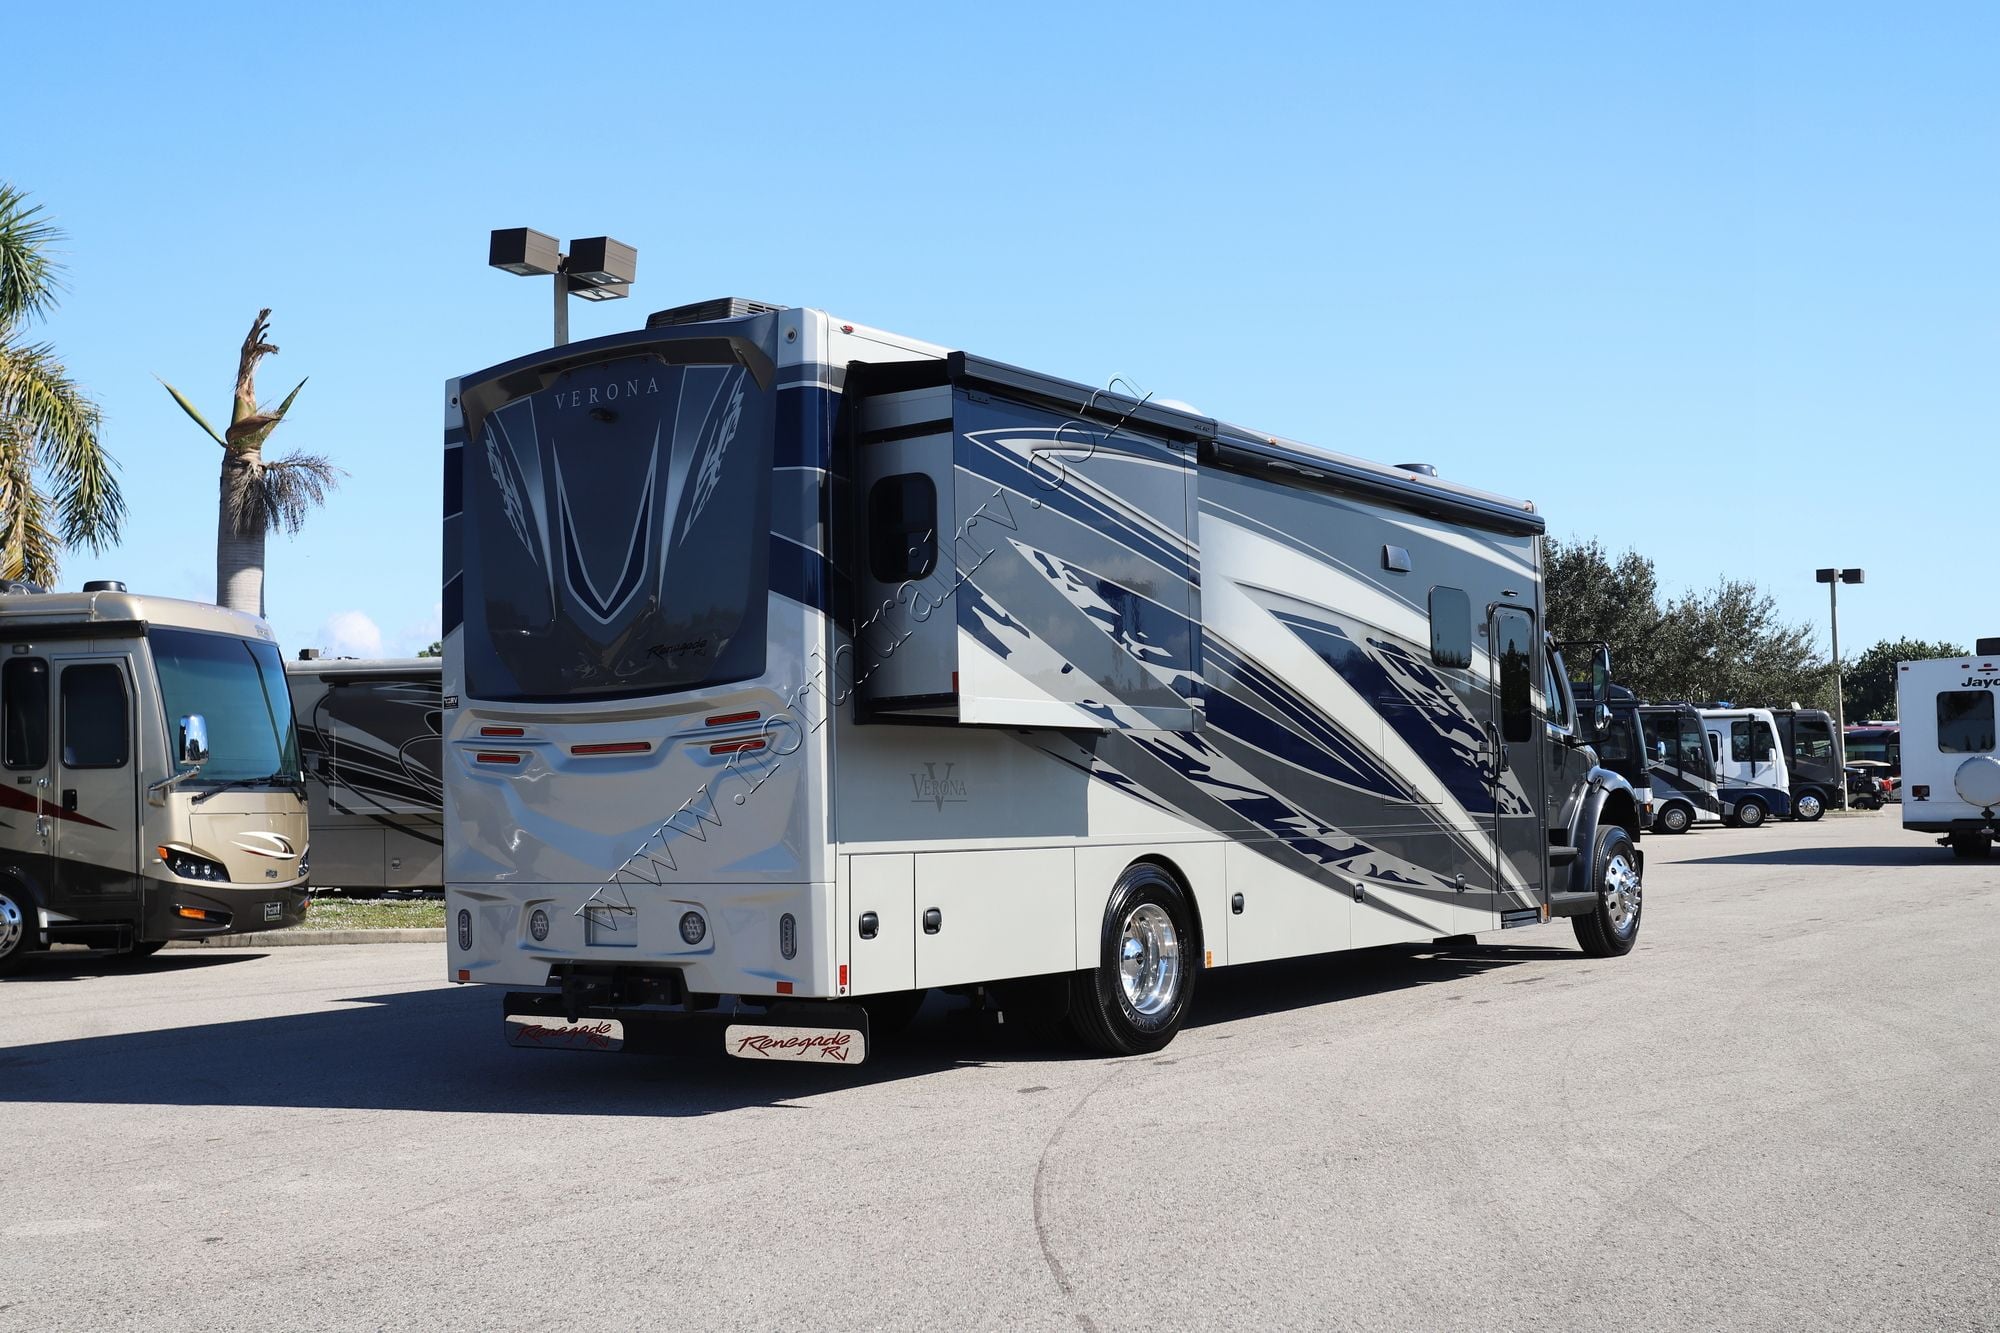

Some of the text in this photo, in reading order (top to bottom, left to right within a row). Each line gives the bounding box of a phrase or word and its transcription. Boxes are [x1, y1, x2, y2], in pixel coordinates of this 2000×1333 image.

[554, 376, 659, 409] VERONA
[515, 1021, 612, 1045] Renegade
[737, 1031, 851, 1057] Renegade
[820, 1046, 849, 1061] RV
